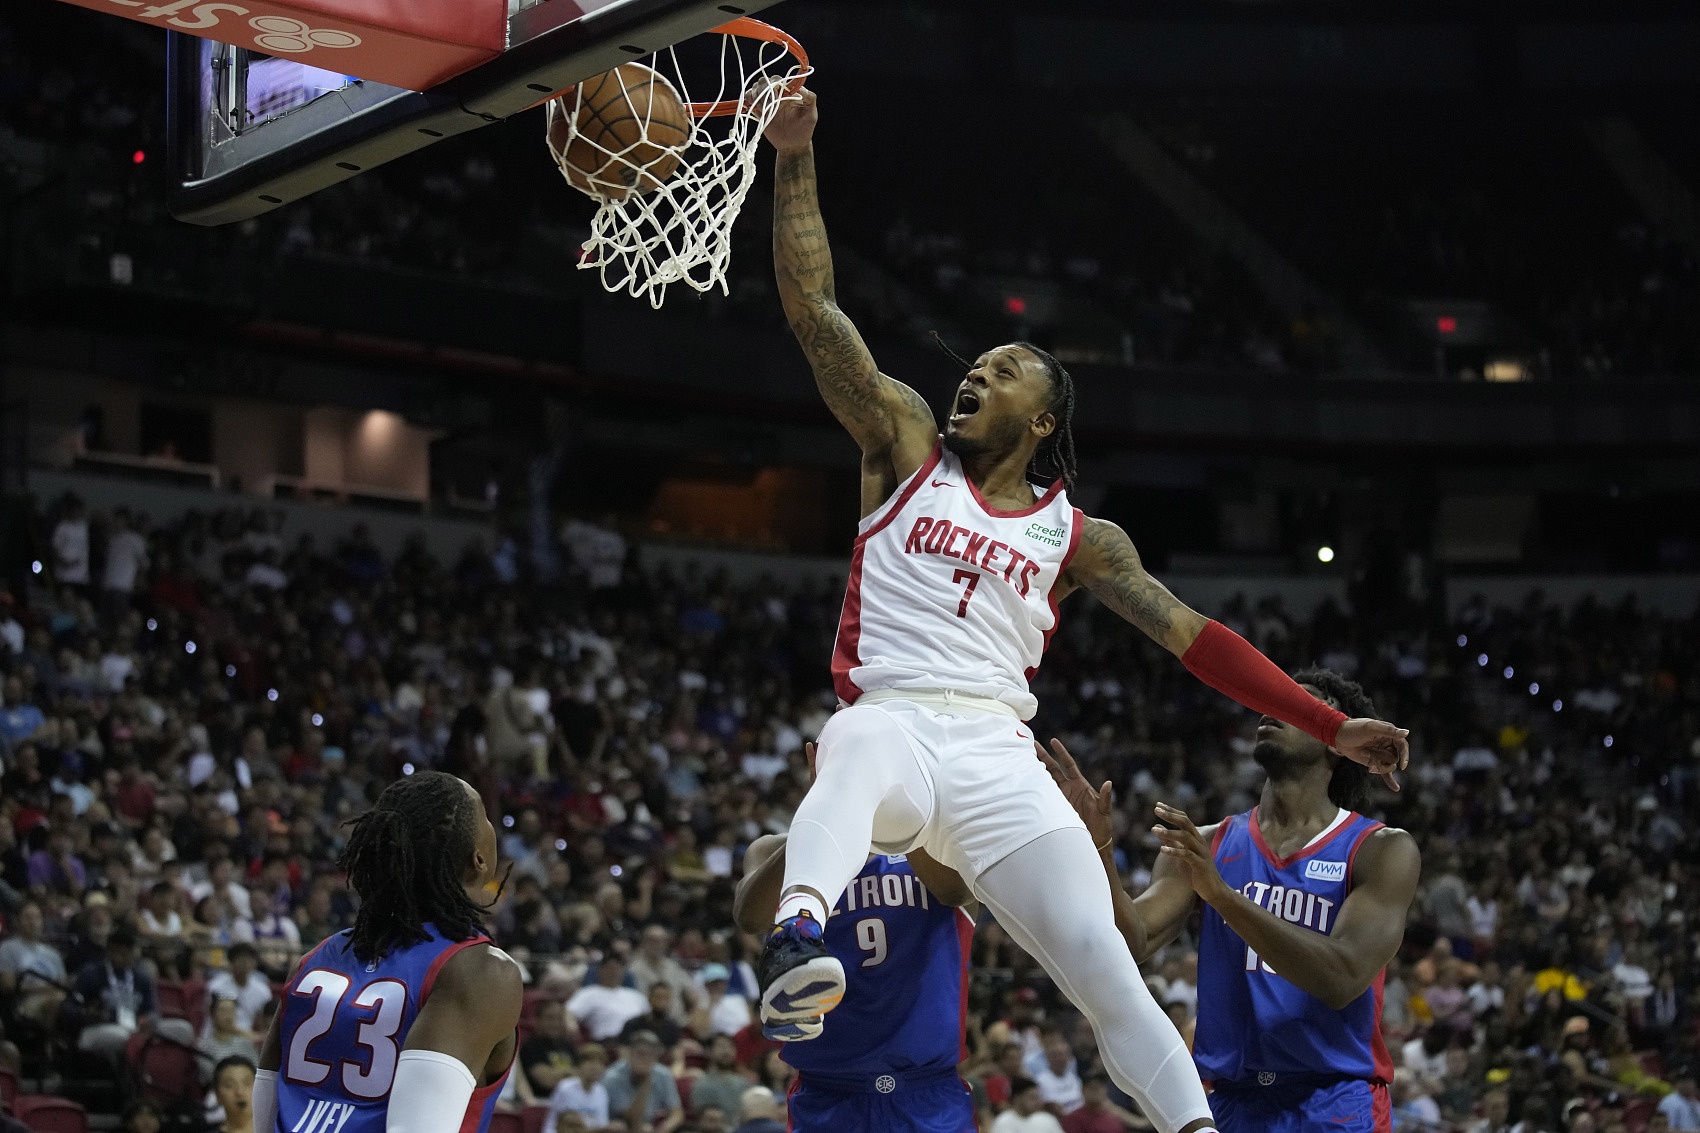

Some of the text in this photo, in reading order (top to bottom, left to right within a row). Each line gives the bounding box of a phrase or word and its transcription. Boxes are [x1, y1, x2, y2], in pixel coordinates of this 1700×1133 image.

[115, 0, 250, 29] St
[1024, 527, 1062, 548] karma
[1031, 522, 1066, 538] credit
[904, 516, 1041, 601] ROCKETS
[952, 568, 981, 619] 7
[1309, 861, 1343, 876] UWM
[829, 874, 929, 917] TROIT
[1224, 881, 1334, 933] TROIT
[856, 917, 889, 968] 9
[285, 967, 408, 1101] 23
[291, 1098, 356, 1133] IVEY
